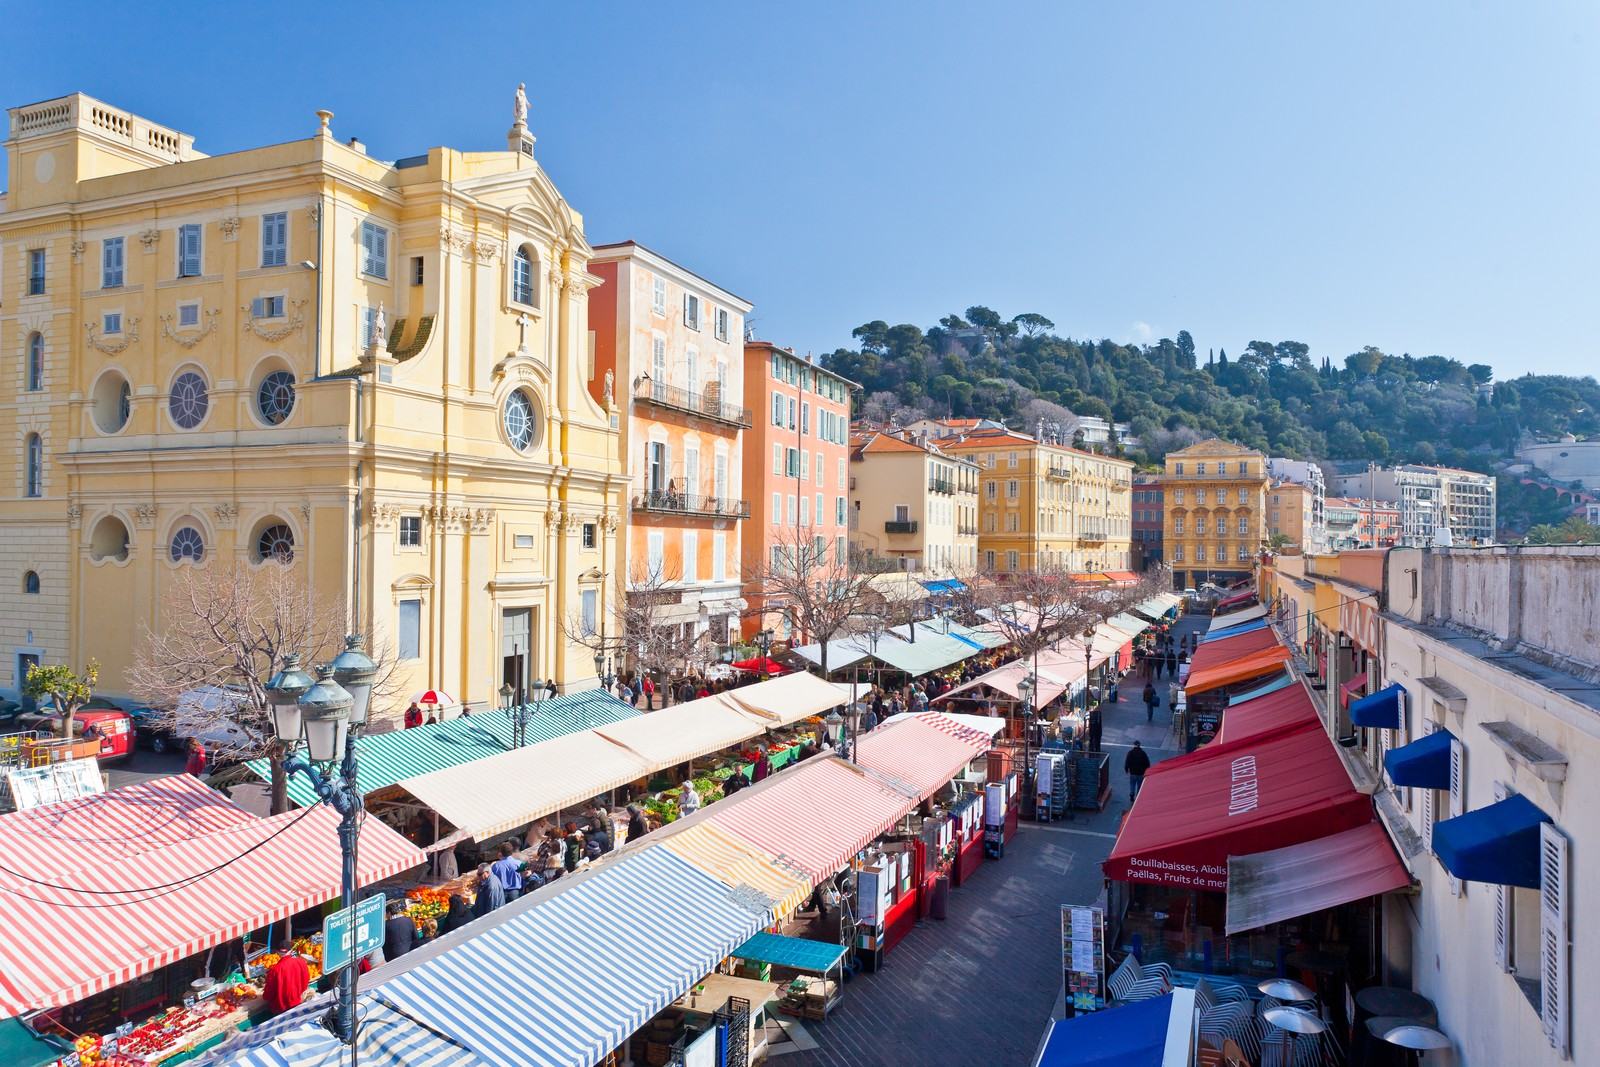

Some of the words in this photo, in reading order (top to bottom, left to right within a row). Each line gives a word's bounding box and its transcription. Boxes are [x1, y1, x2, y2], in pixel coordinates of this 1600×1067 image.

[1231, 756, 1256, 781] CHEZ
[1130, 857, 1198, 873] Bouillabaisses,
[1127, 869, 1162, 881] Paëllas,
[1164, 872, 1191, 884] Fruits
[1193, 876, 1205, 886] de
